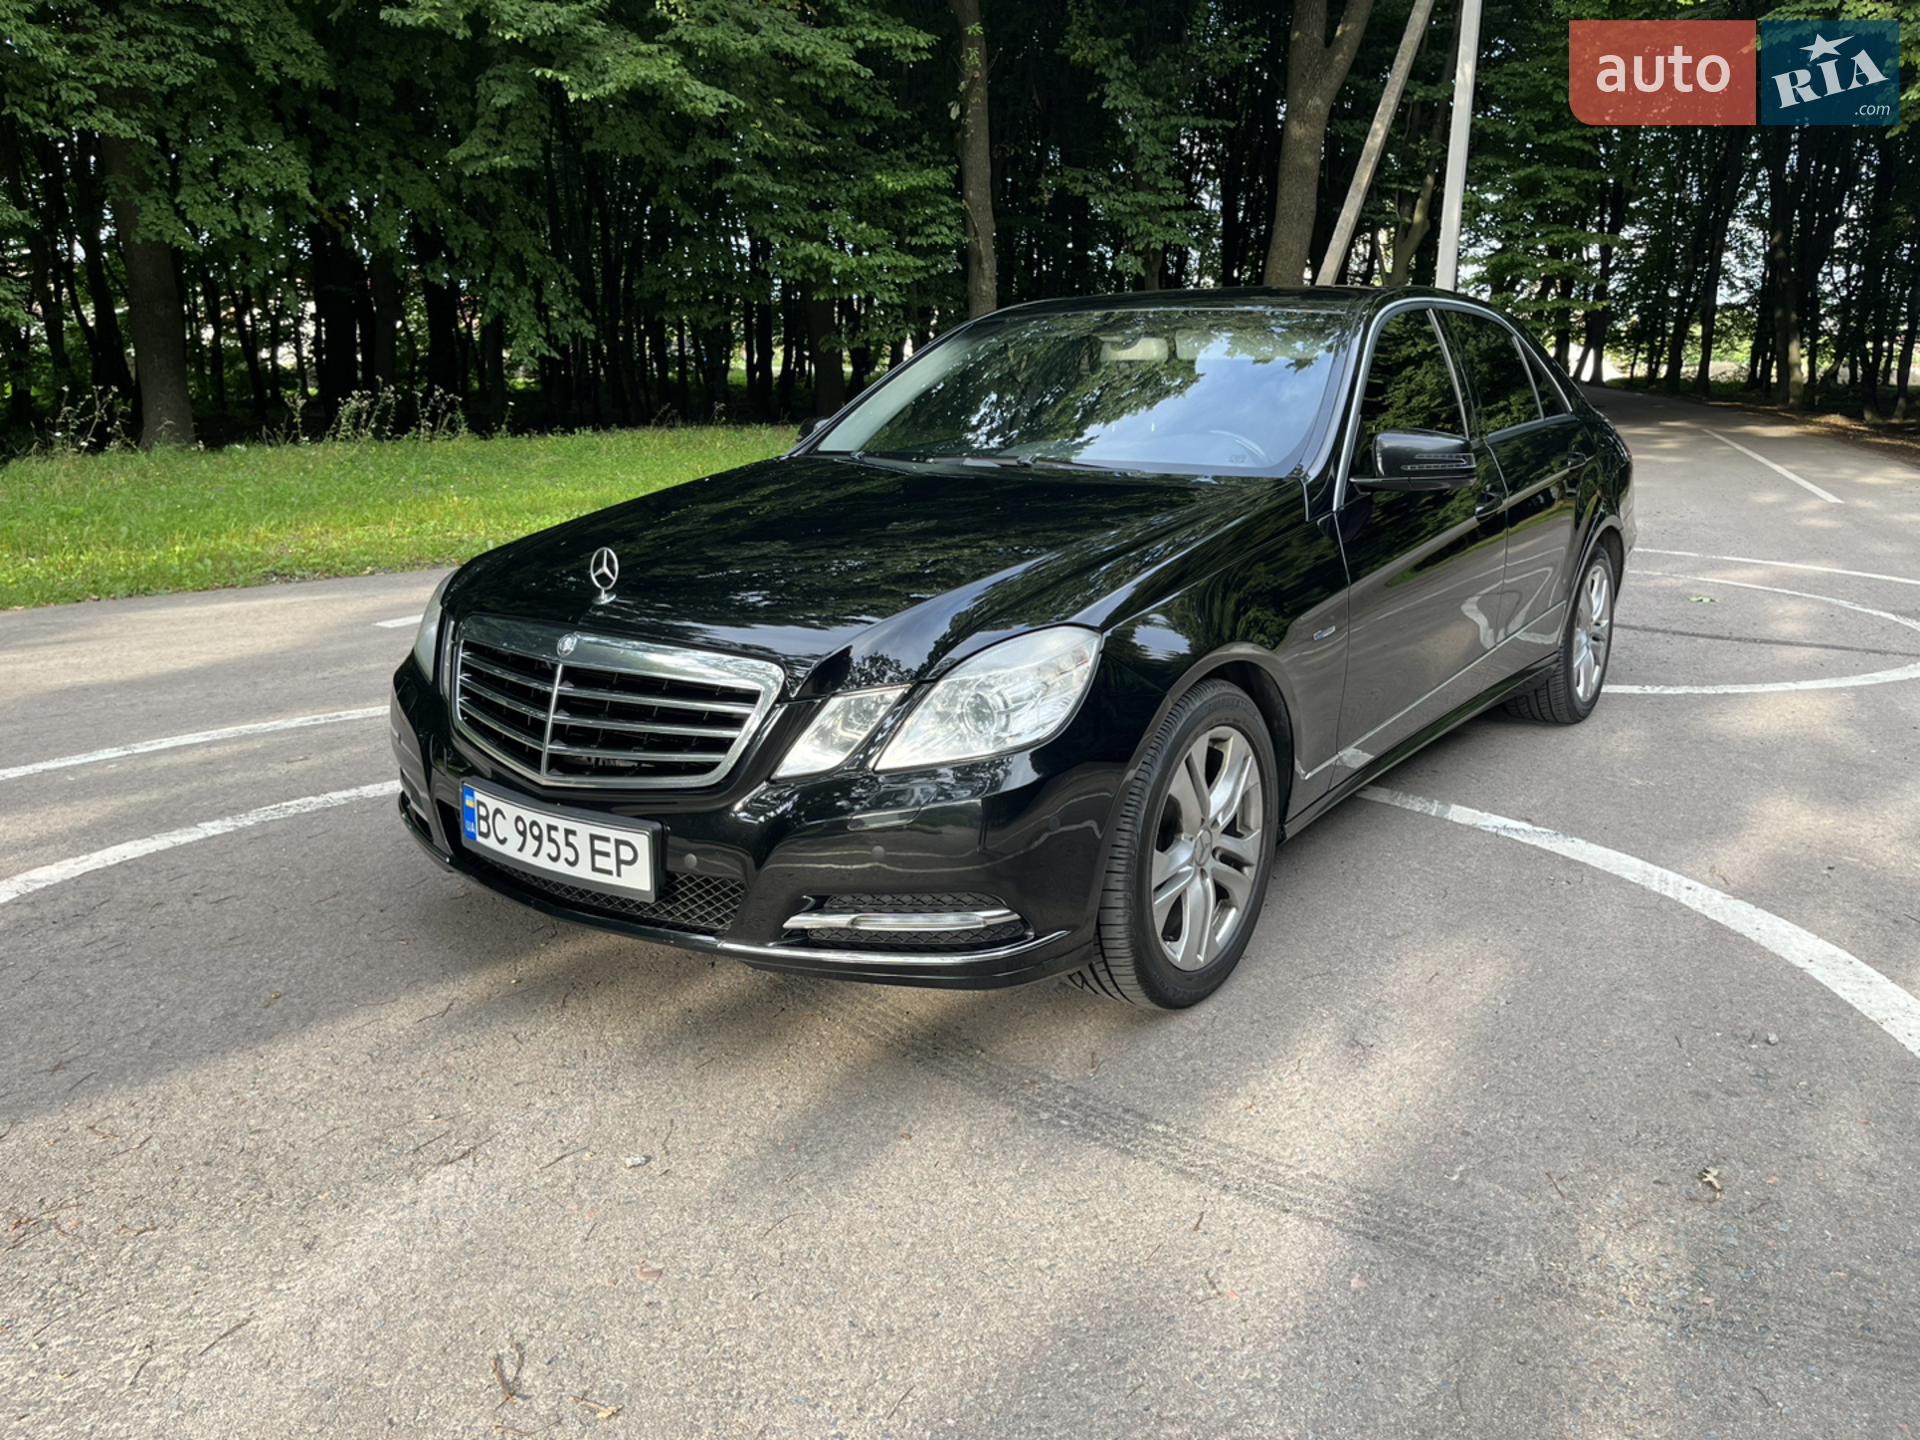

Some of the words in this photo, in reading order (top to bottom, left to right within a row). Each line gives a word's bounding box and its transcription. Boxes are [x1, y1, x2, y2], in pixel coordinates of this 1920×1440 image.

[476, 800, 508, 845] BC
[514, 815, 579, 867] 9955
[589, 833, 638, 877] EP
